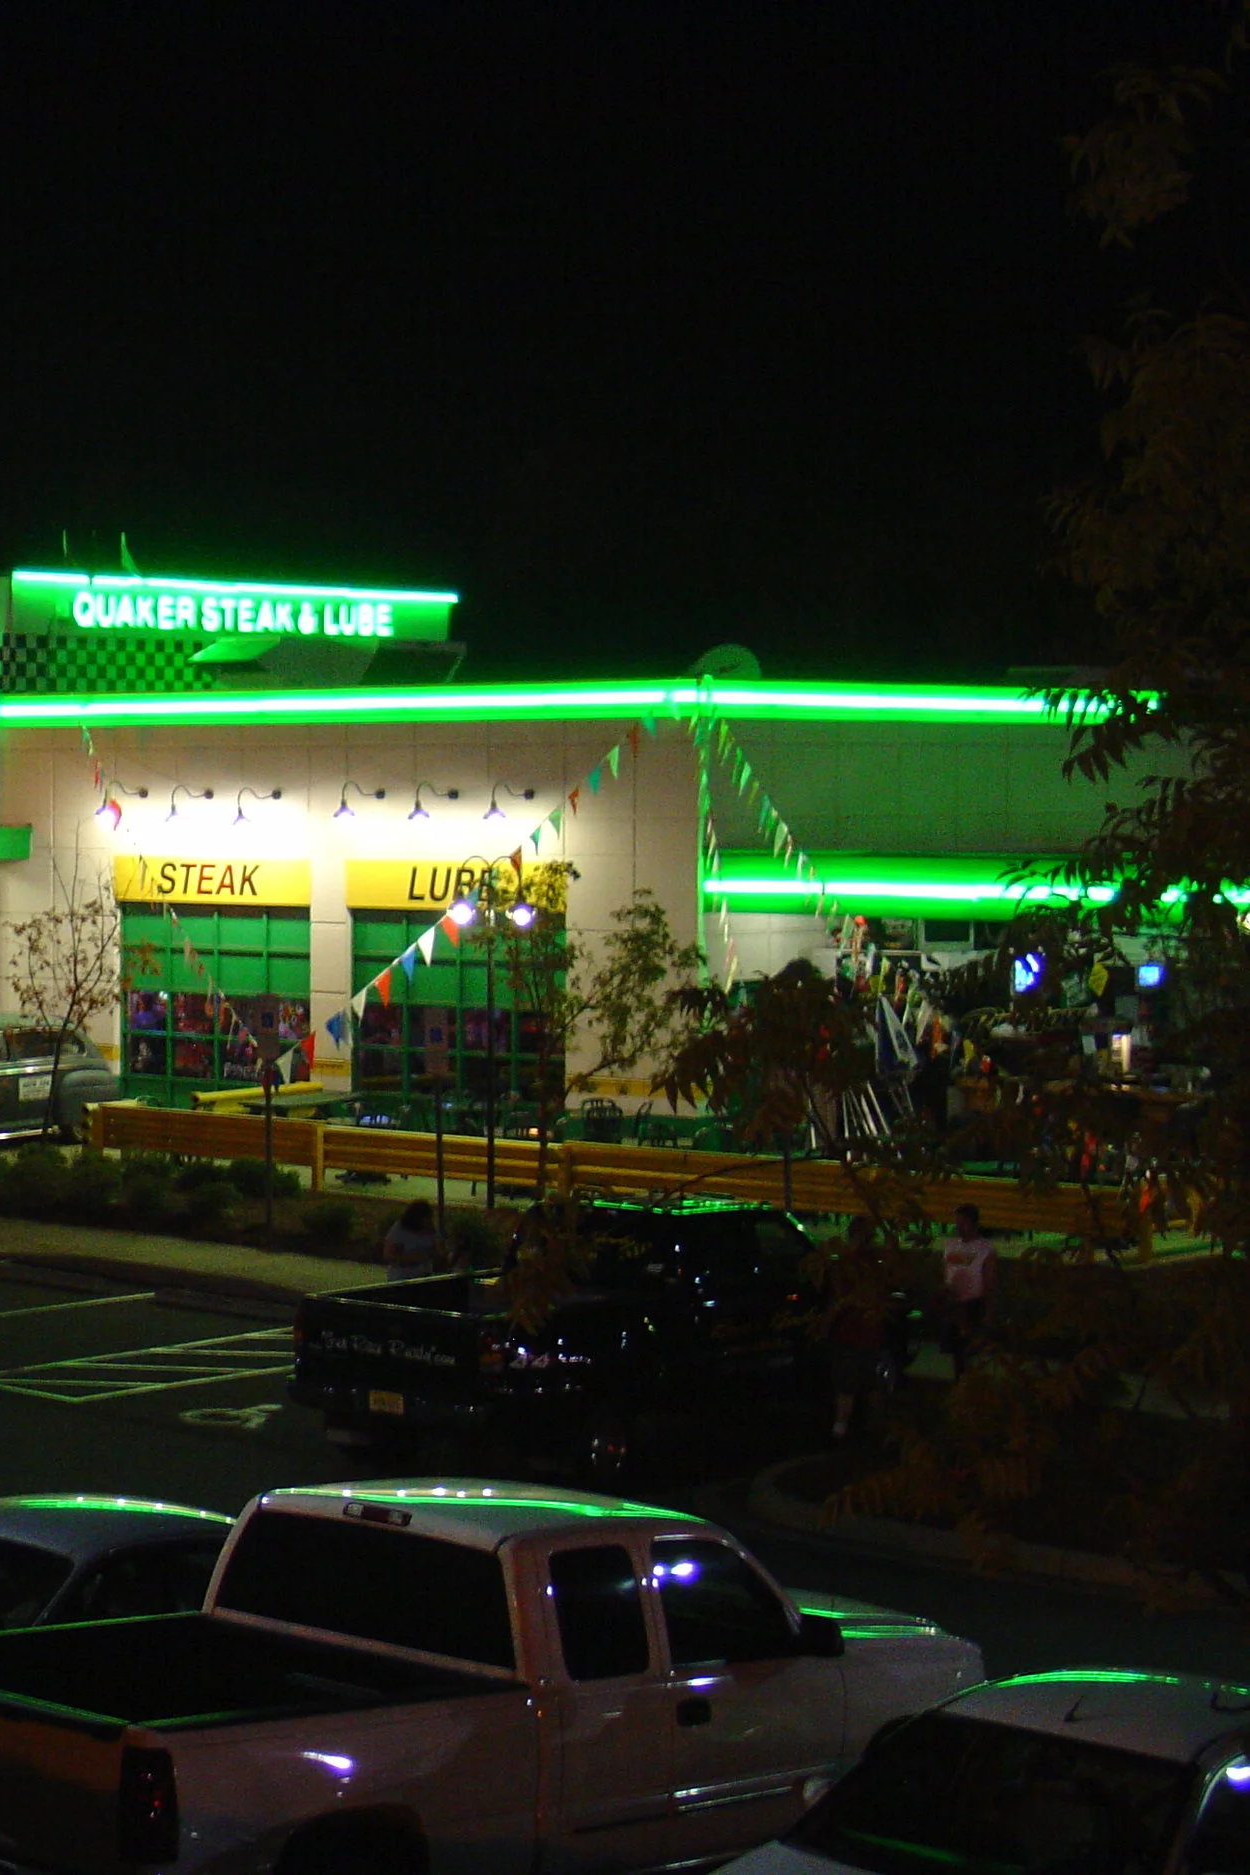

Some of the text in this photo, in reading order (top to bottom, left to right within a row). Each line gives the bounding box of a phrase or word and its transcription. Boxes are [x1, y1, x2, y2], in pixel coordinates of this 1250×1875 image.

[72, 590, 394, 637] QUAKER STEAK & LUBE
[157, 863, 260, 895] STEAK
